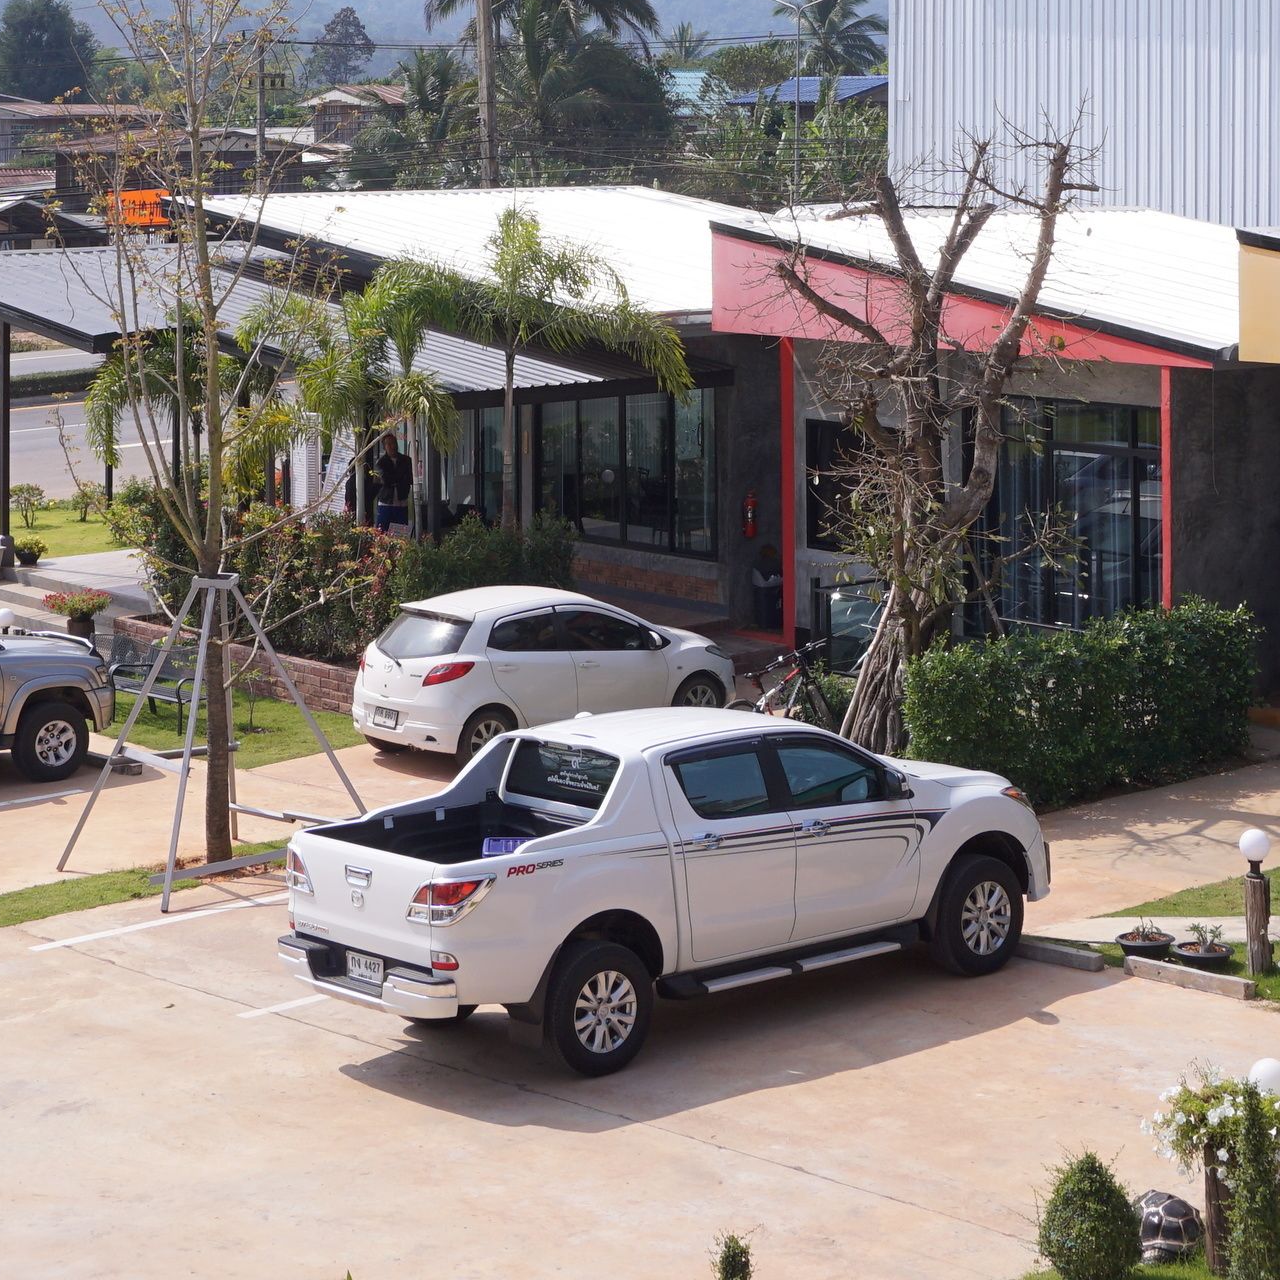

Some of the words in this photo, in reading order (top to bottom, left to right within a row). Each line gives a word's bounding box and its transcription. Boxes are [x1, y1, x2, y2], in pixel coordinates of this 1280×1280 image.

[507, 864, 536, 878] PRO
[536, 858, 564, 870] SERIES
[364, 959, 381, 974] 4427
